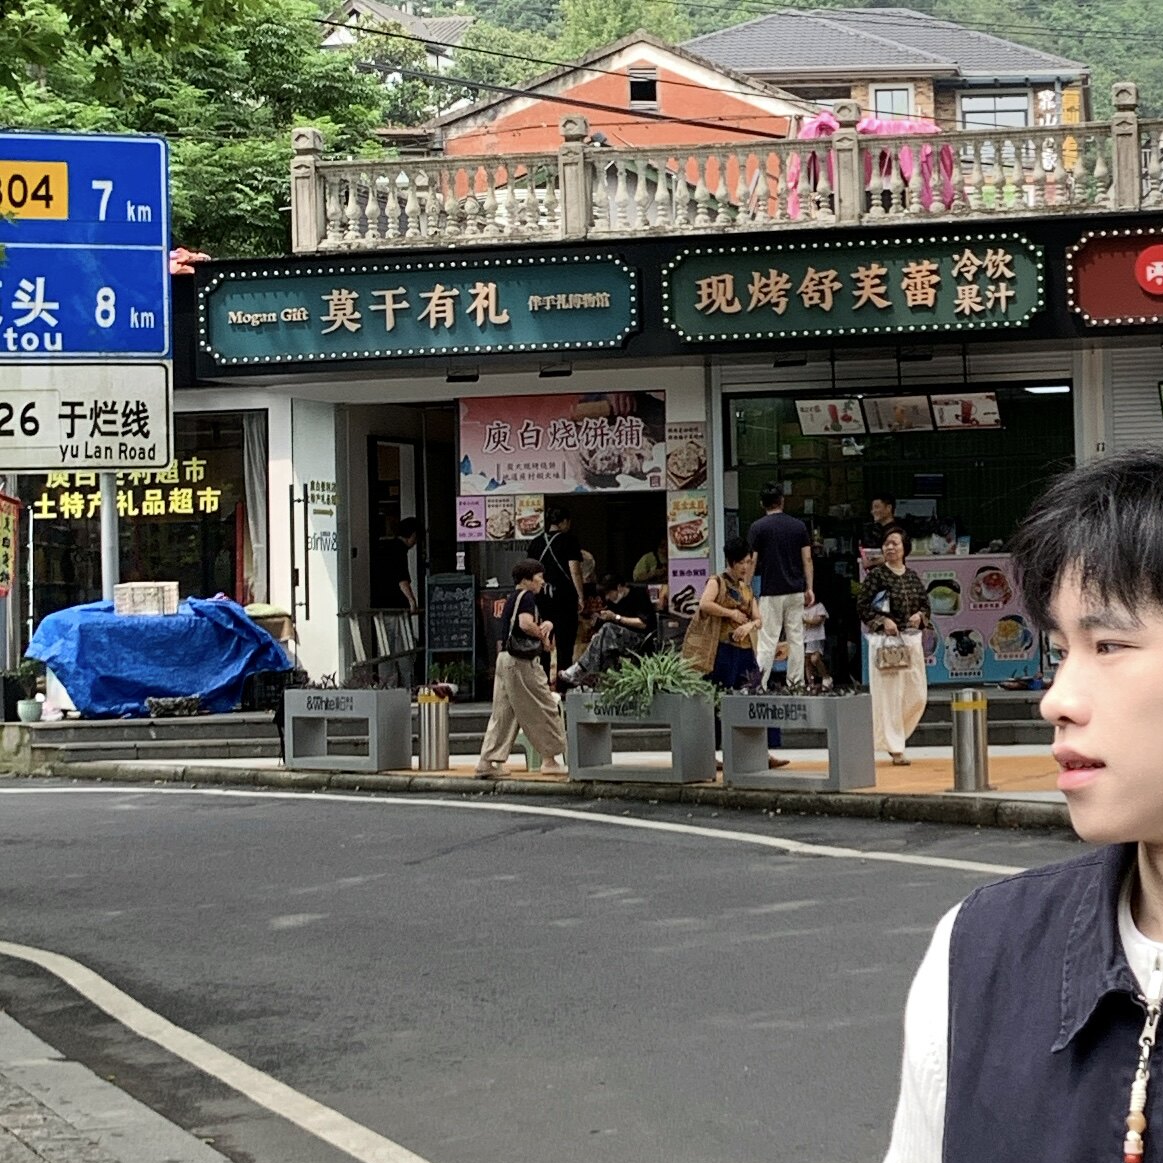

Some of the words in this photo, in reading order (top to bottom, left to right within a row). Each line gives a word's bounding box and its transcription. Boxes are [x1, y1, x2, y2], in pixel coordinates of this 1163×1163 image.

[0, 174, 53, 208] 04
[92, 180, 113, 221] 7
[127, 200, 152, 222] km
[952, 248, 1016, 281] 冷饮
[0, 277, 59, 327] 头
[95, 287, 116, 328] 8
[130, 307, 155, 329] km
[694, 259, 941, 315] 现烤舒芙蕾
[953, 283, 1016, 315] 果汁
[228, 310, 278, 326] Mogan
[280, 308, 310, 322] Gift
[320, 282, 510, 334] 莫干有礼
[4, 327, 62, 351] tou
[58, 399, 151, 439] 于烂线
[84, 441, 113, 460] Lan
[118, 443, 156, 460] Road
[33, 487, 222, 519] 土特产礼品超市
